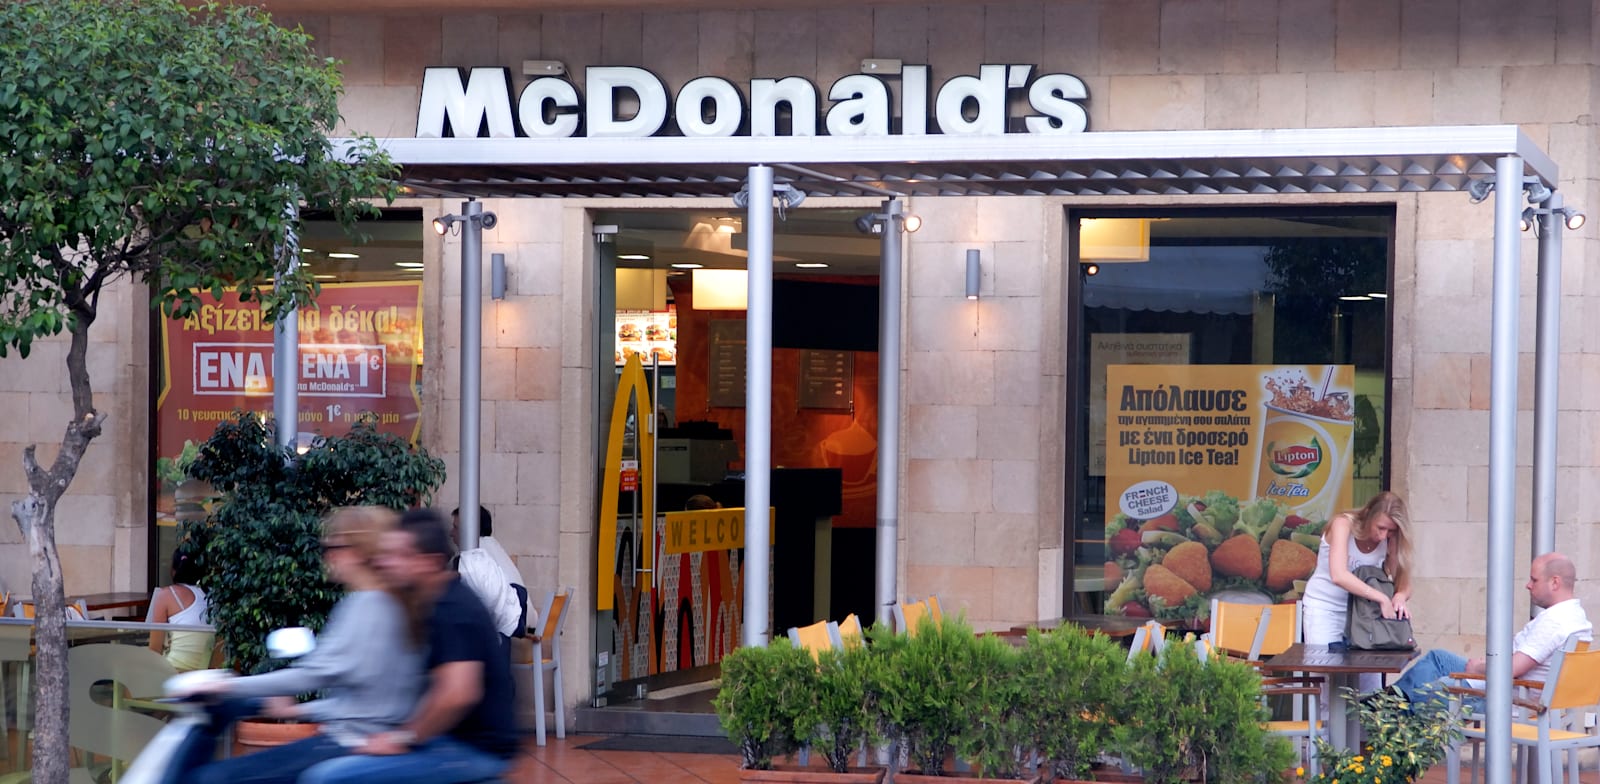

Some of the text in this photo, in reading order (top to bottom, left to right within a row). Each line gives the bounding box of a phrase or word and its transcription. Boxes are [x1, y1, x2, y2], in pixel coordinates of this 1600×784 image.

[415, 64, 1091, 137] McDonald's
[329, 304, 398, 333] δέκα!
[199, 351, 268, 389] ΕΝΑ
[302, 353, 350, 379] ΕΝΑ
[1120, 384, 1247, 411] Απόλαυσε
[177, 408, 189, 421] 10
[1117, 414, 1251, 426] την αγαπημένη σου σαλάτα
[1119, 427, 1249, 447] με ένα δροσερό
[1128, 448, 1239, 466] Lipton Ice Tea!
[1276, 451, 1315, 463] Lipton
[1266, 480, 1310, 497] Ice Tea
[1128, 494, 1169, 510] CHEESE
[1137, 504, 1164, 516] Salad
[671, 515, 739, 547] WELCO
